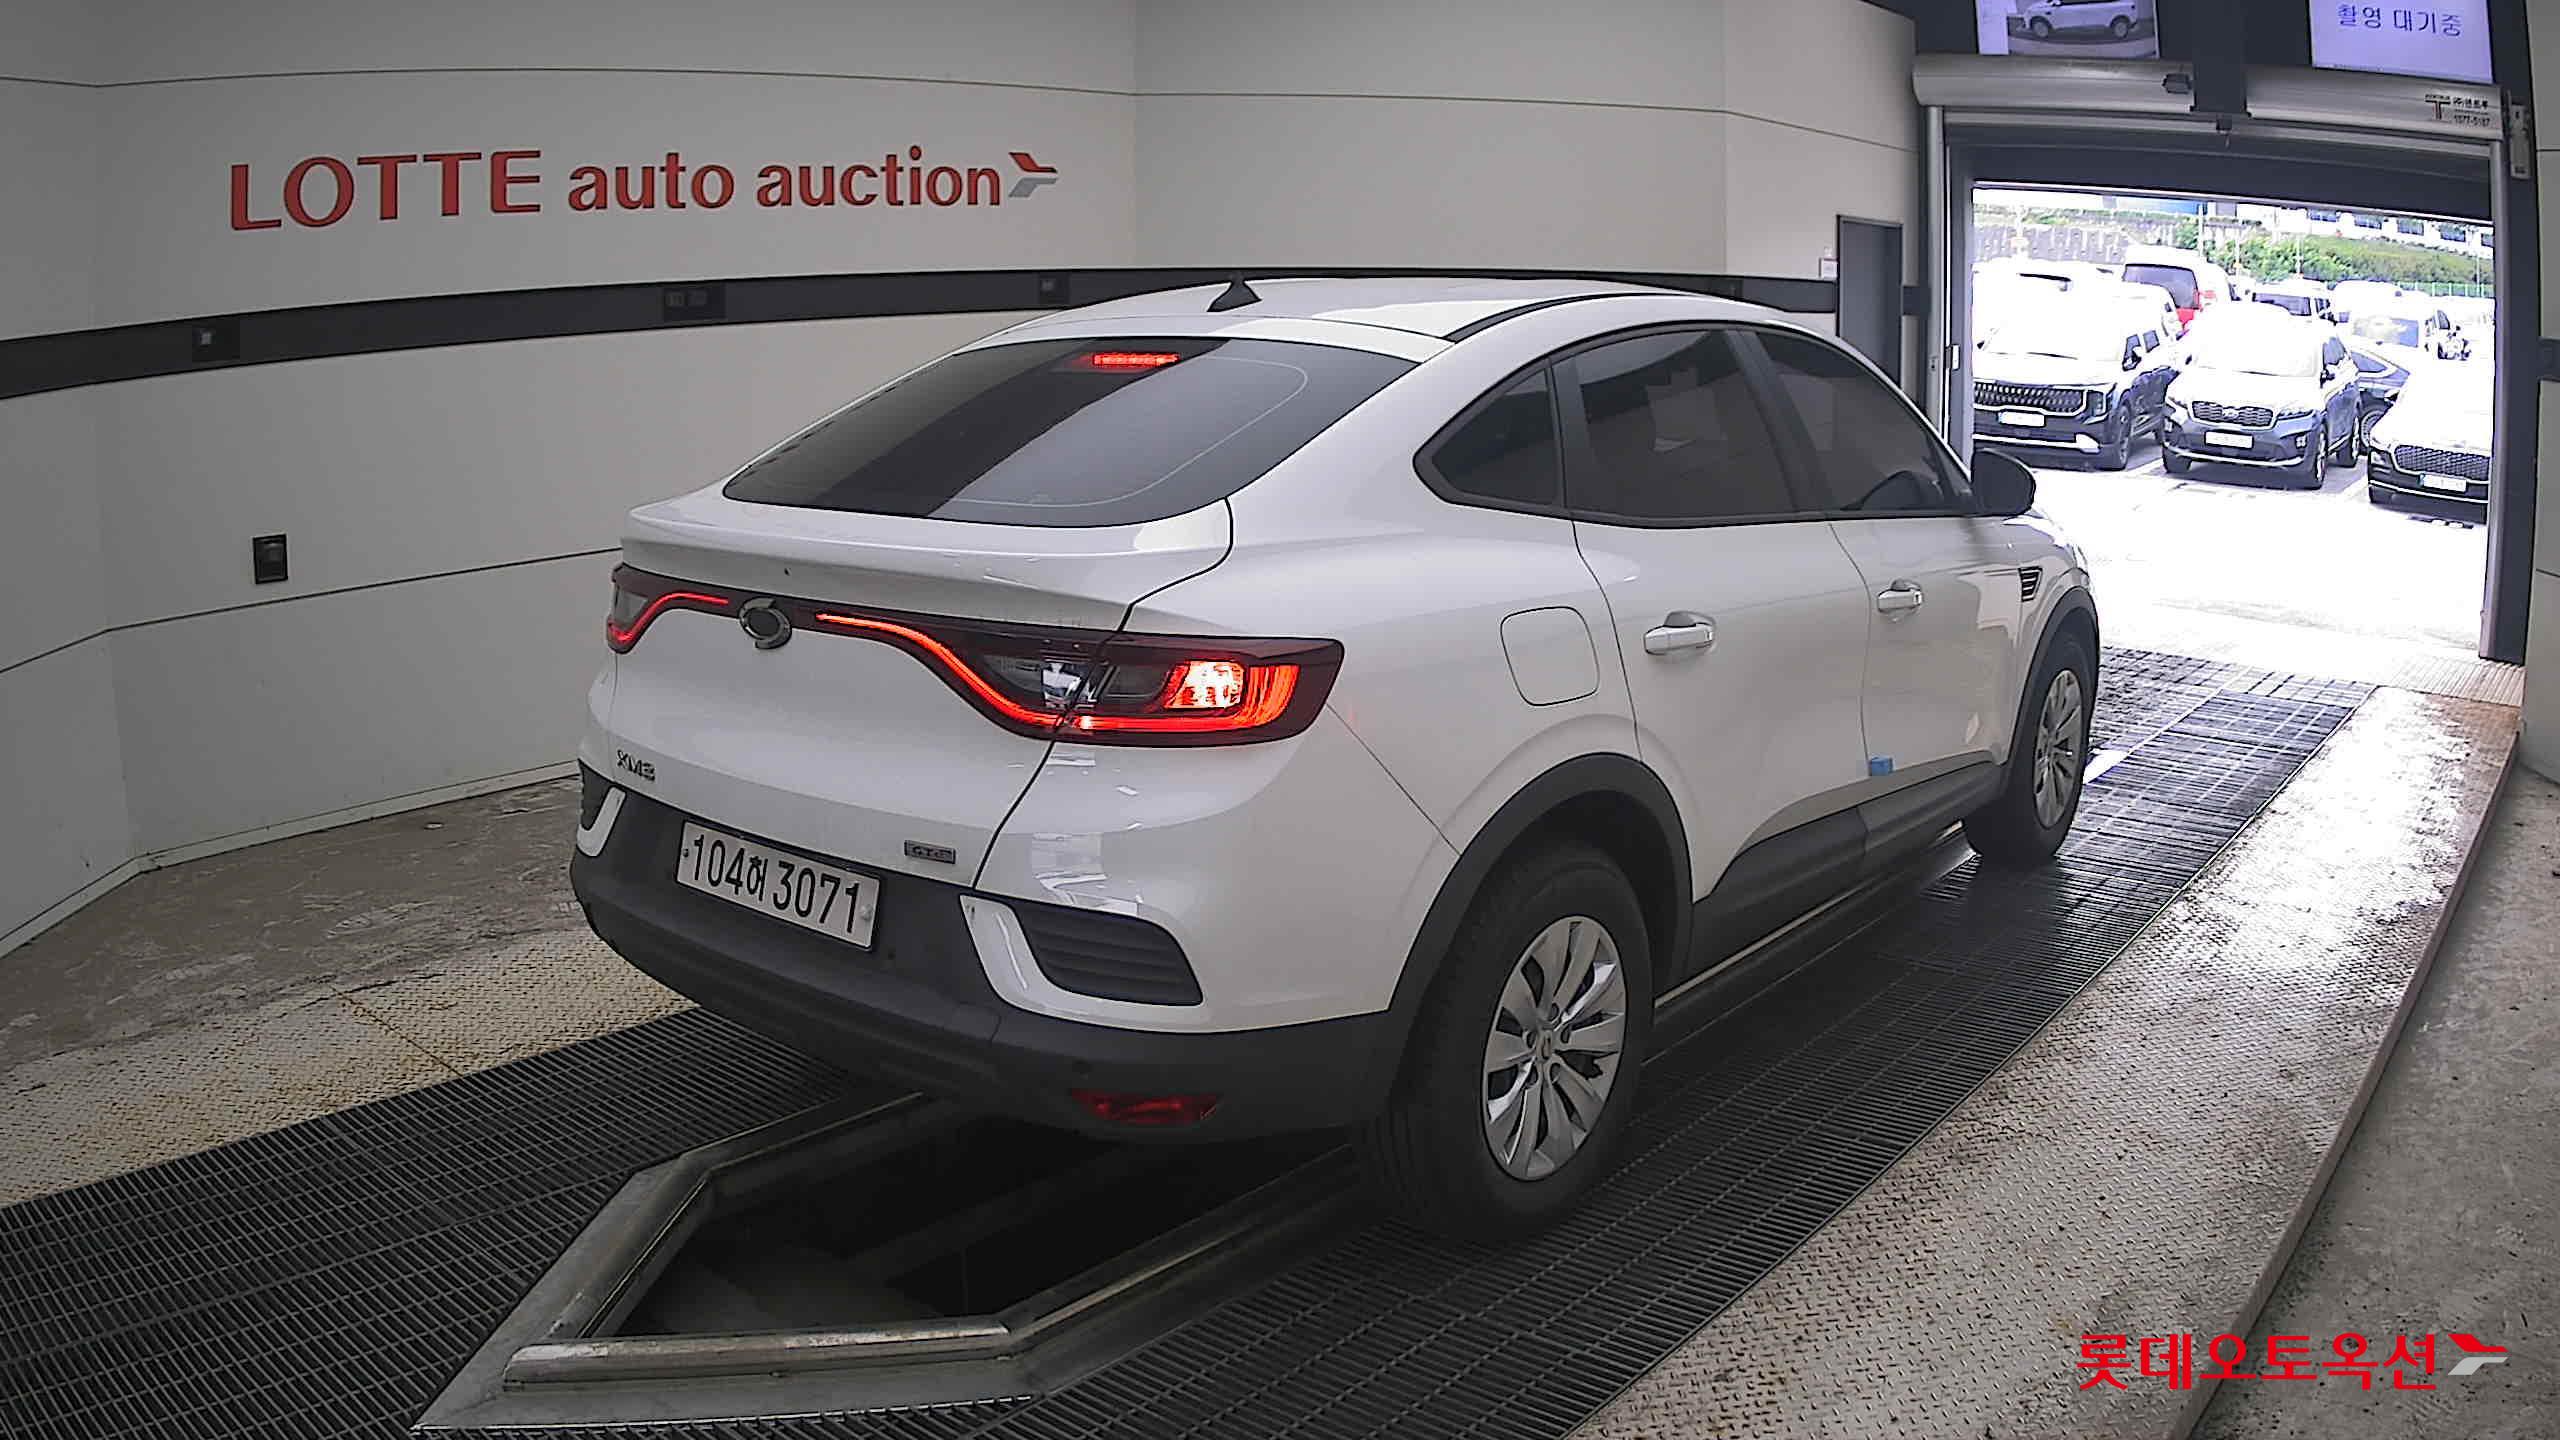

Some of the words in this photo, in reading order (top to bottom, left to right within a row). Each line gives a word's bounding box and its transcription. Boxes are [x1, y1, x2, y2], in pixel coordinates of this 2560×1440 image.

[2337, 3, 2382, 29] 촬영
[2393, 8, 2463, 37] 대기중
[231, 150, 541, 230] LOTTE
[568, 153, 735, 210] auto
[755, 146, 1003, 208] auction
[616, 749, 656, 782] XM3
[693, 834, 769, 903] 104허
[772, 860, 860, 933] 3071
